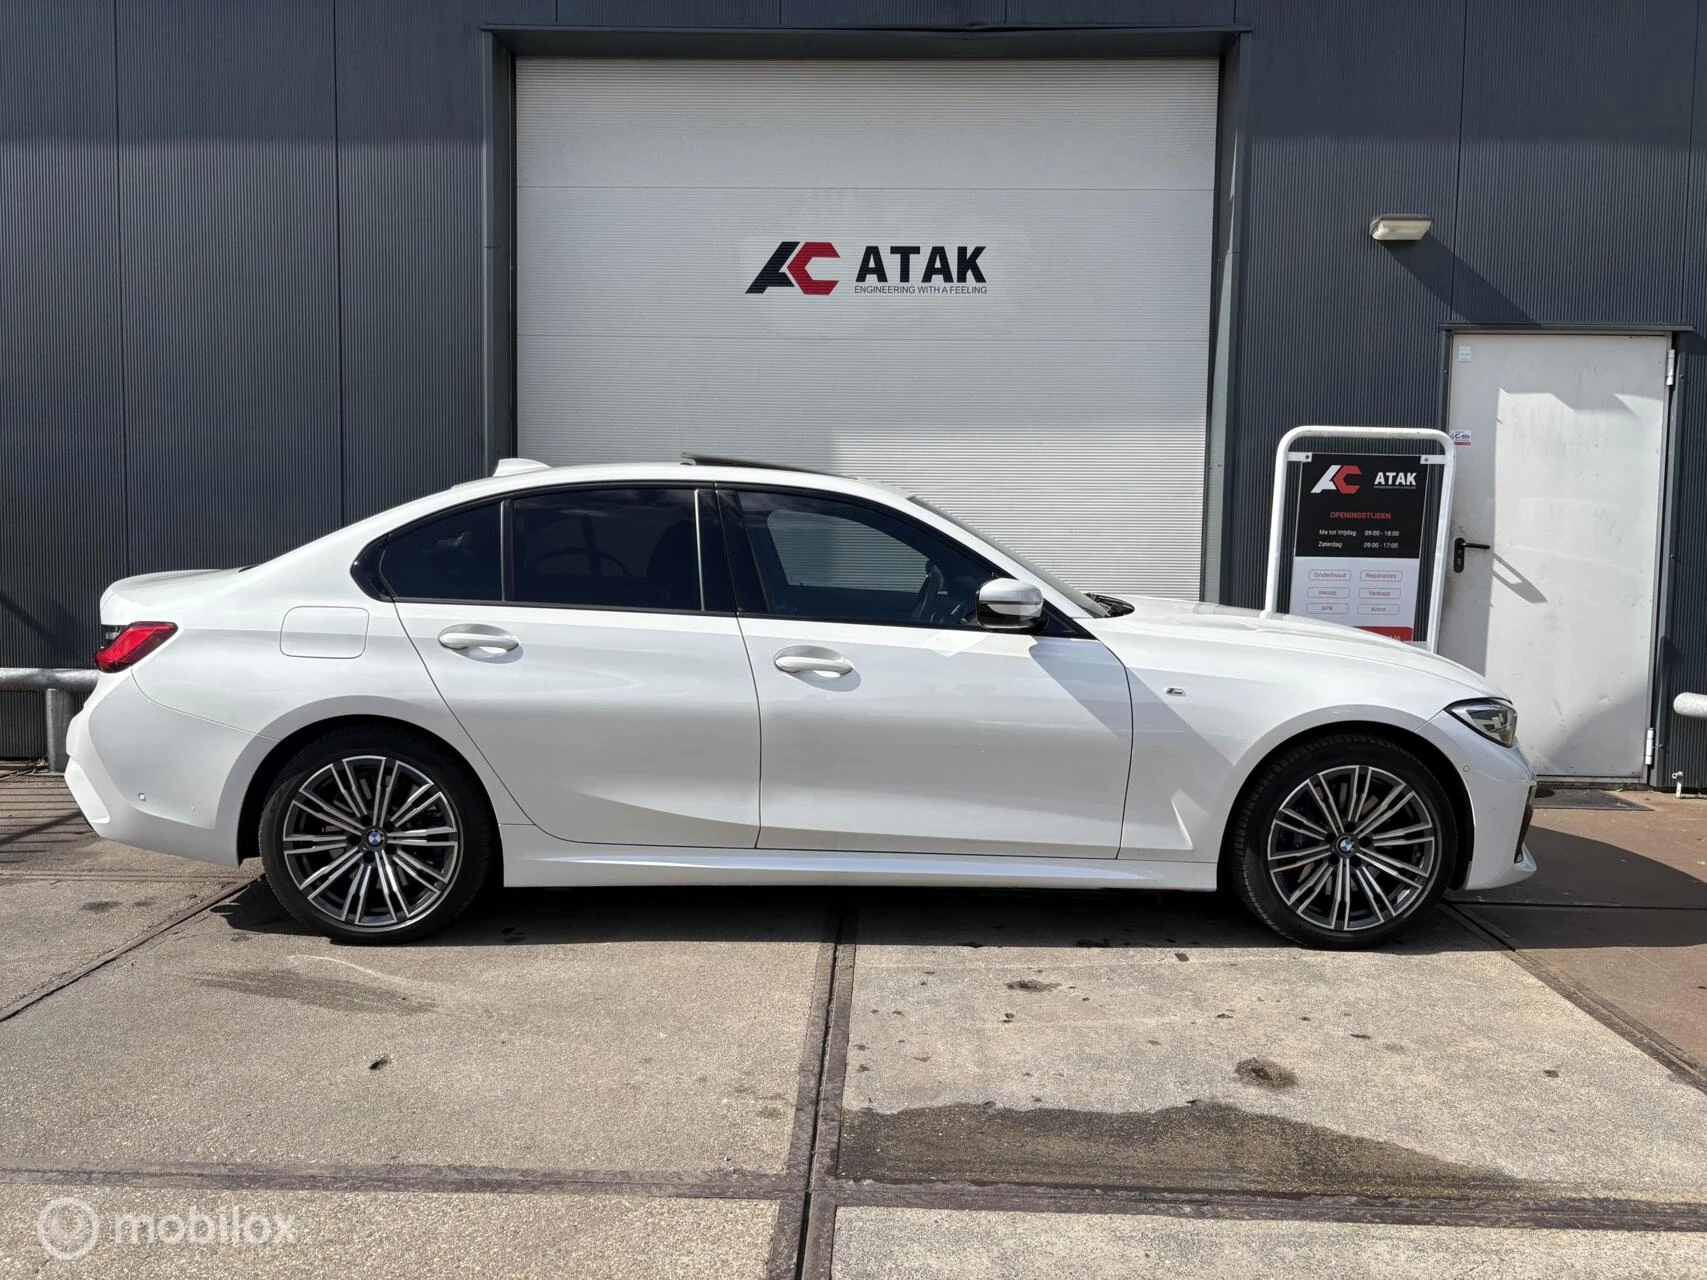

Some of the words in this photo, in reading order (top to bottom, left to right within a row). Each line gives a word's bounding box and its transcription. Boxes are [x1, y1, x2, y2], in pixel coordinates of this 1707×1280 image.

[855, 245, 987, 283] ATAK
[854, 285, 915, 294] ENGINEERING
[917, 285, 941, 294] WITH
[941, 286, 948, 294] A
[949, 286, 988, 295] FEELING
[1374, 472, 1417, 486] ATAK
[1330, 511, 1391, 519] OPENINGSTIJDEN
[1338, 529, 1357, 537] Vrijdag
